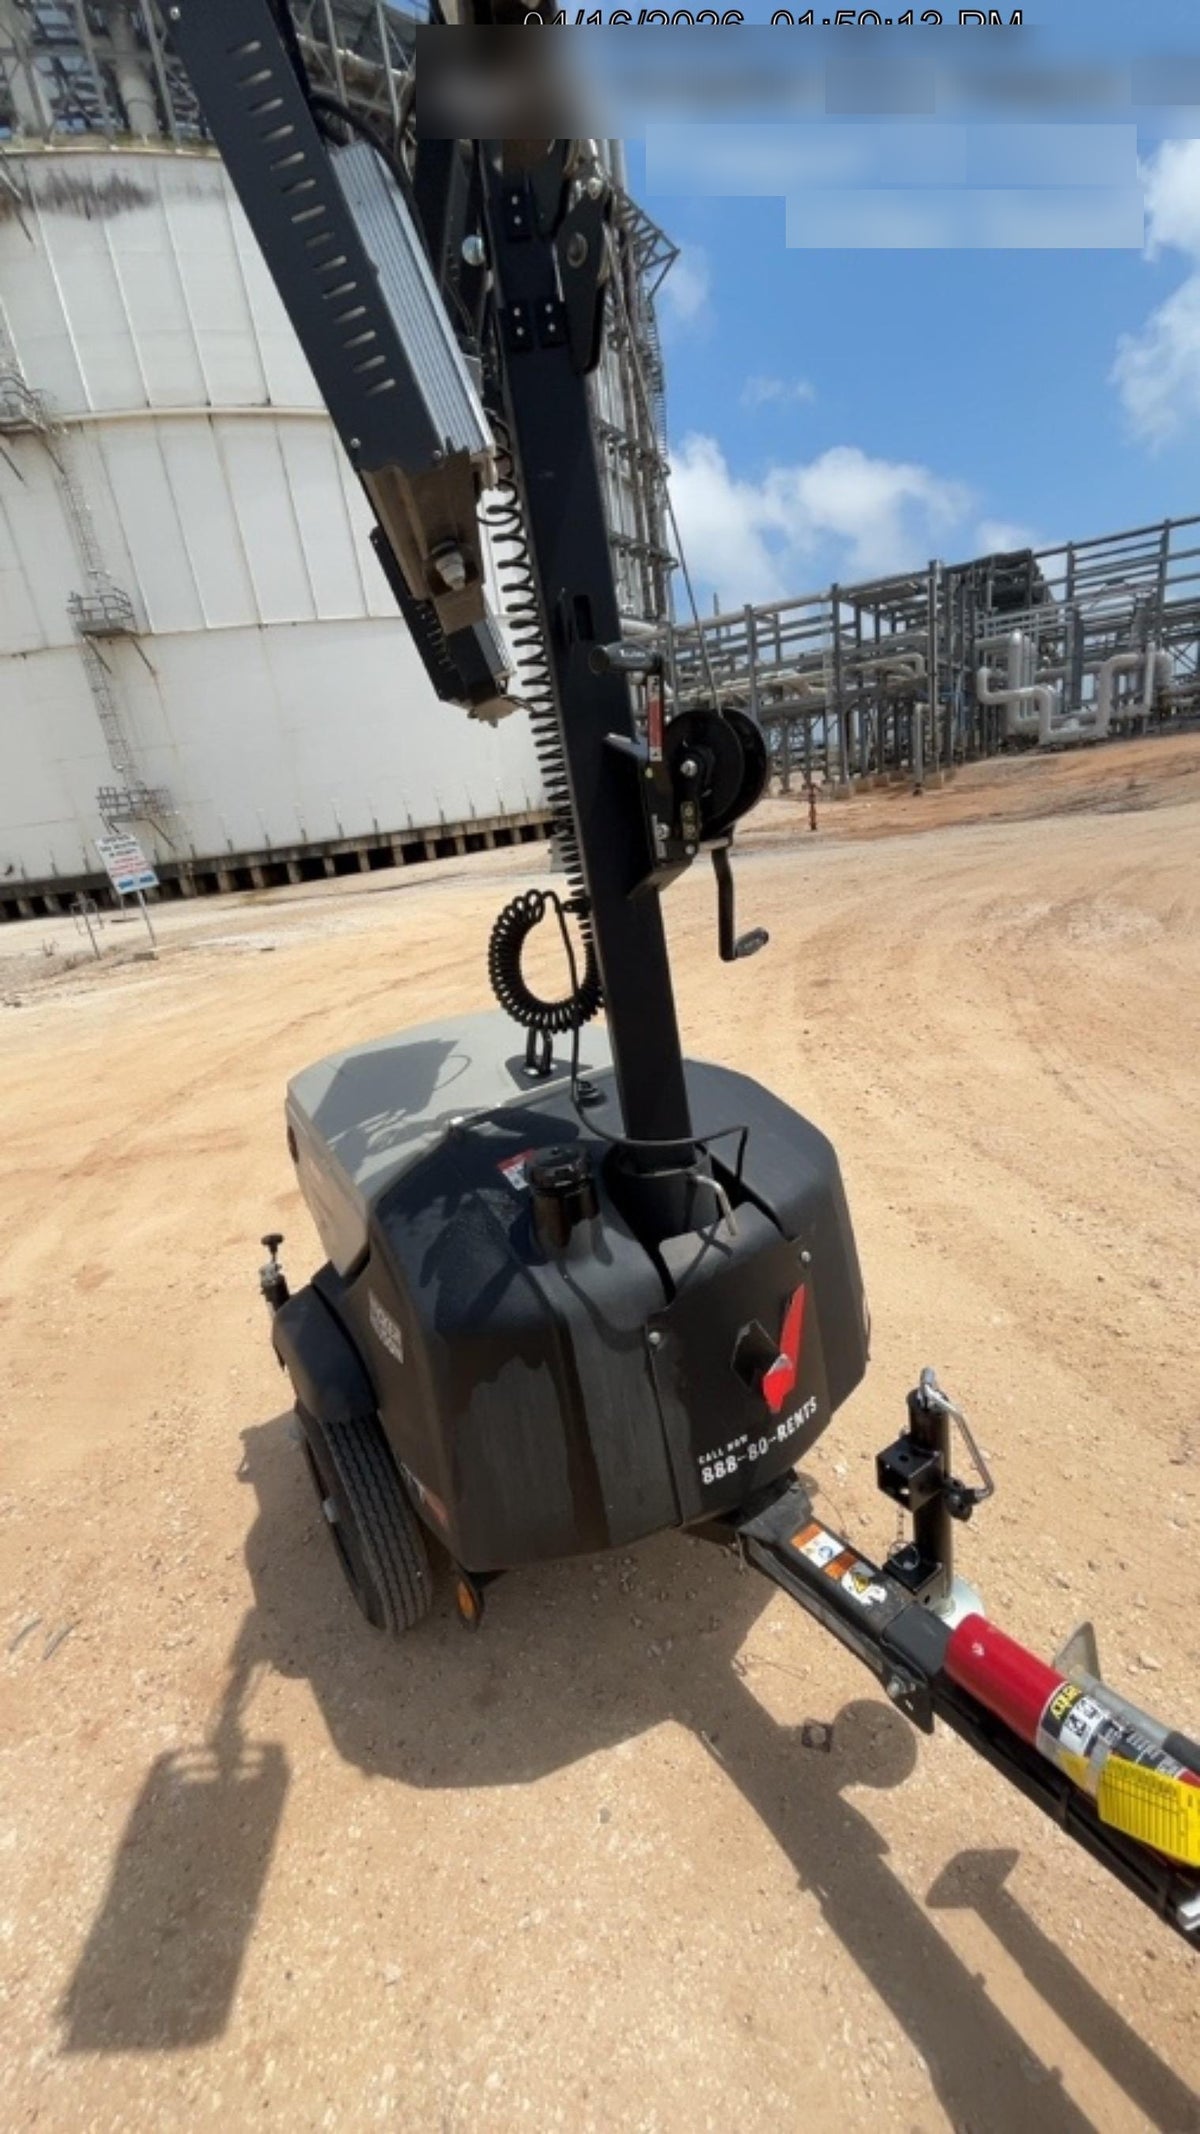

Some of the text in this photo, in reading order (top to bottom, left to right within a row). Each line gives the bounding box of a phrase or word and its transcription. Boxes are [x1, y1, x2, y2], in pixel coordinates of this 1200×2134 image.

[698, 1434, 748, 1465] CALL NOW
[702, 1396, 817, 1485] 888-80-RENTS
